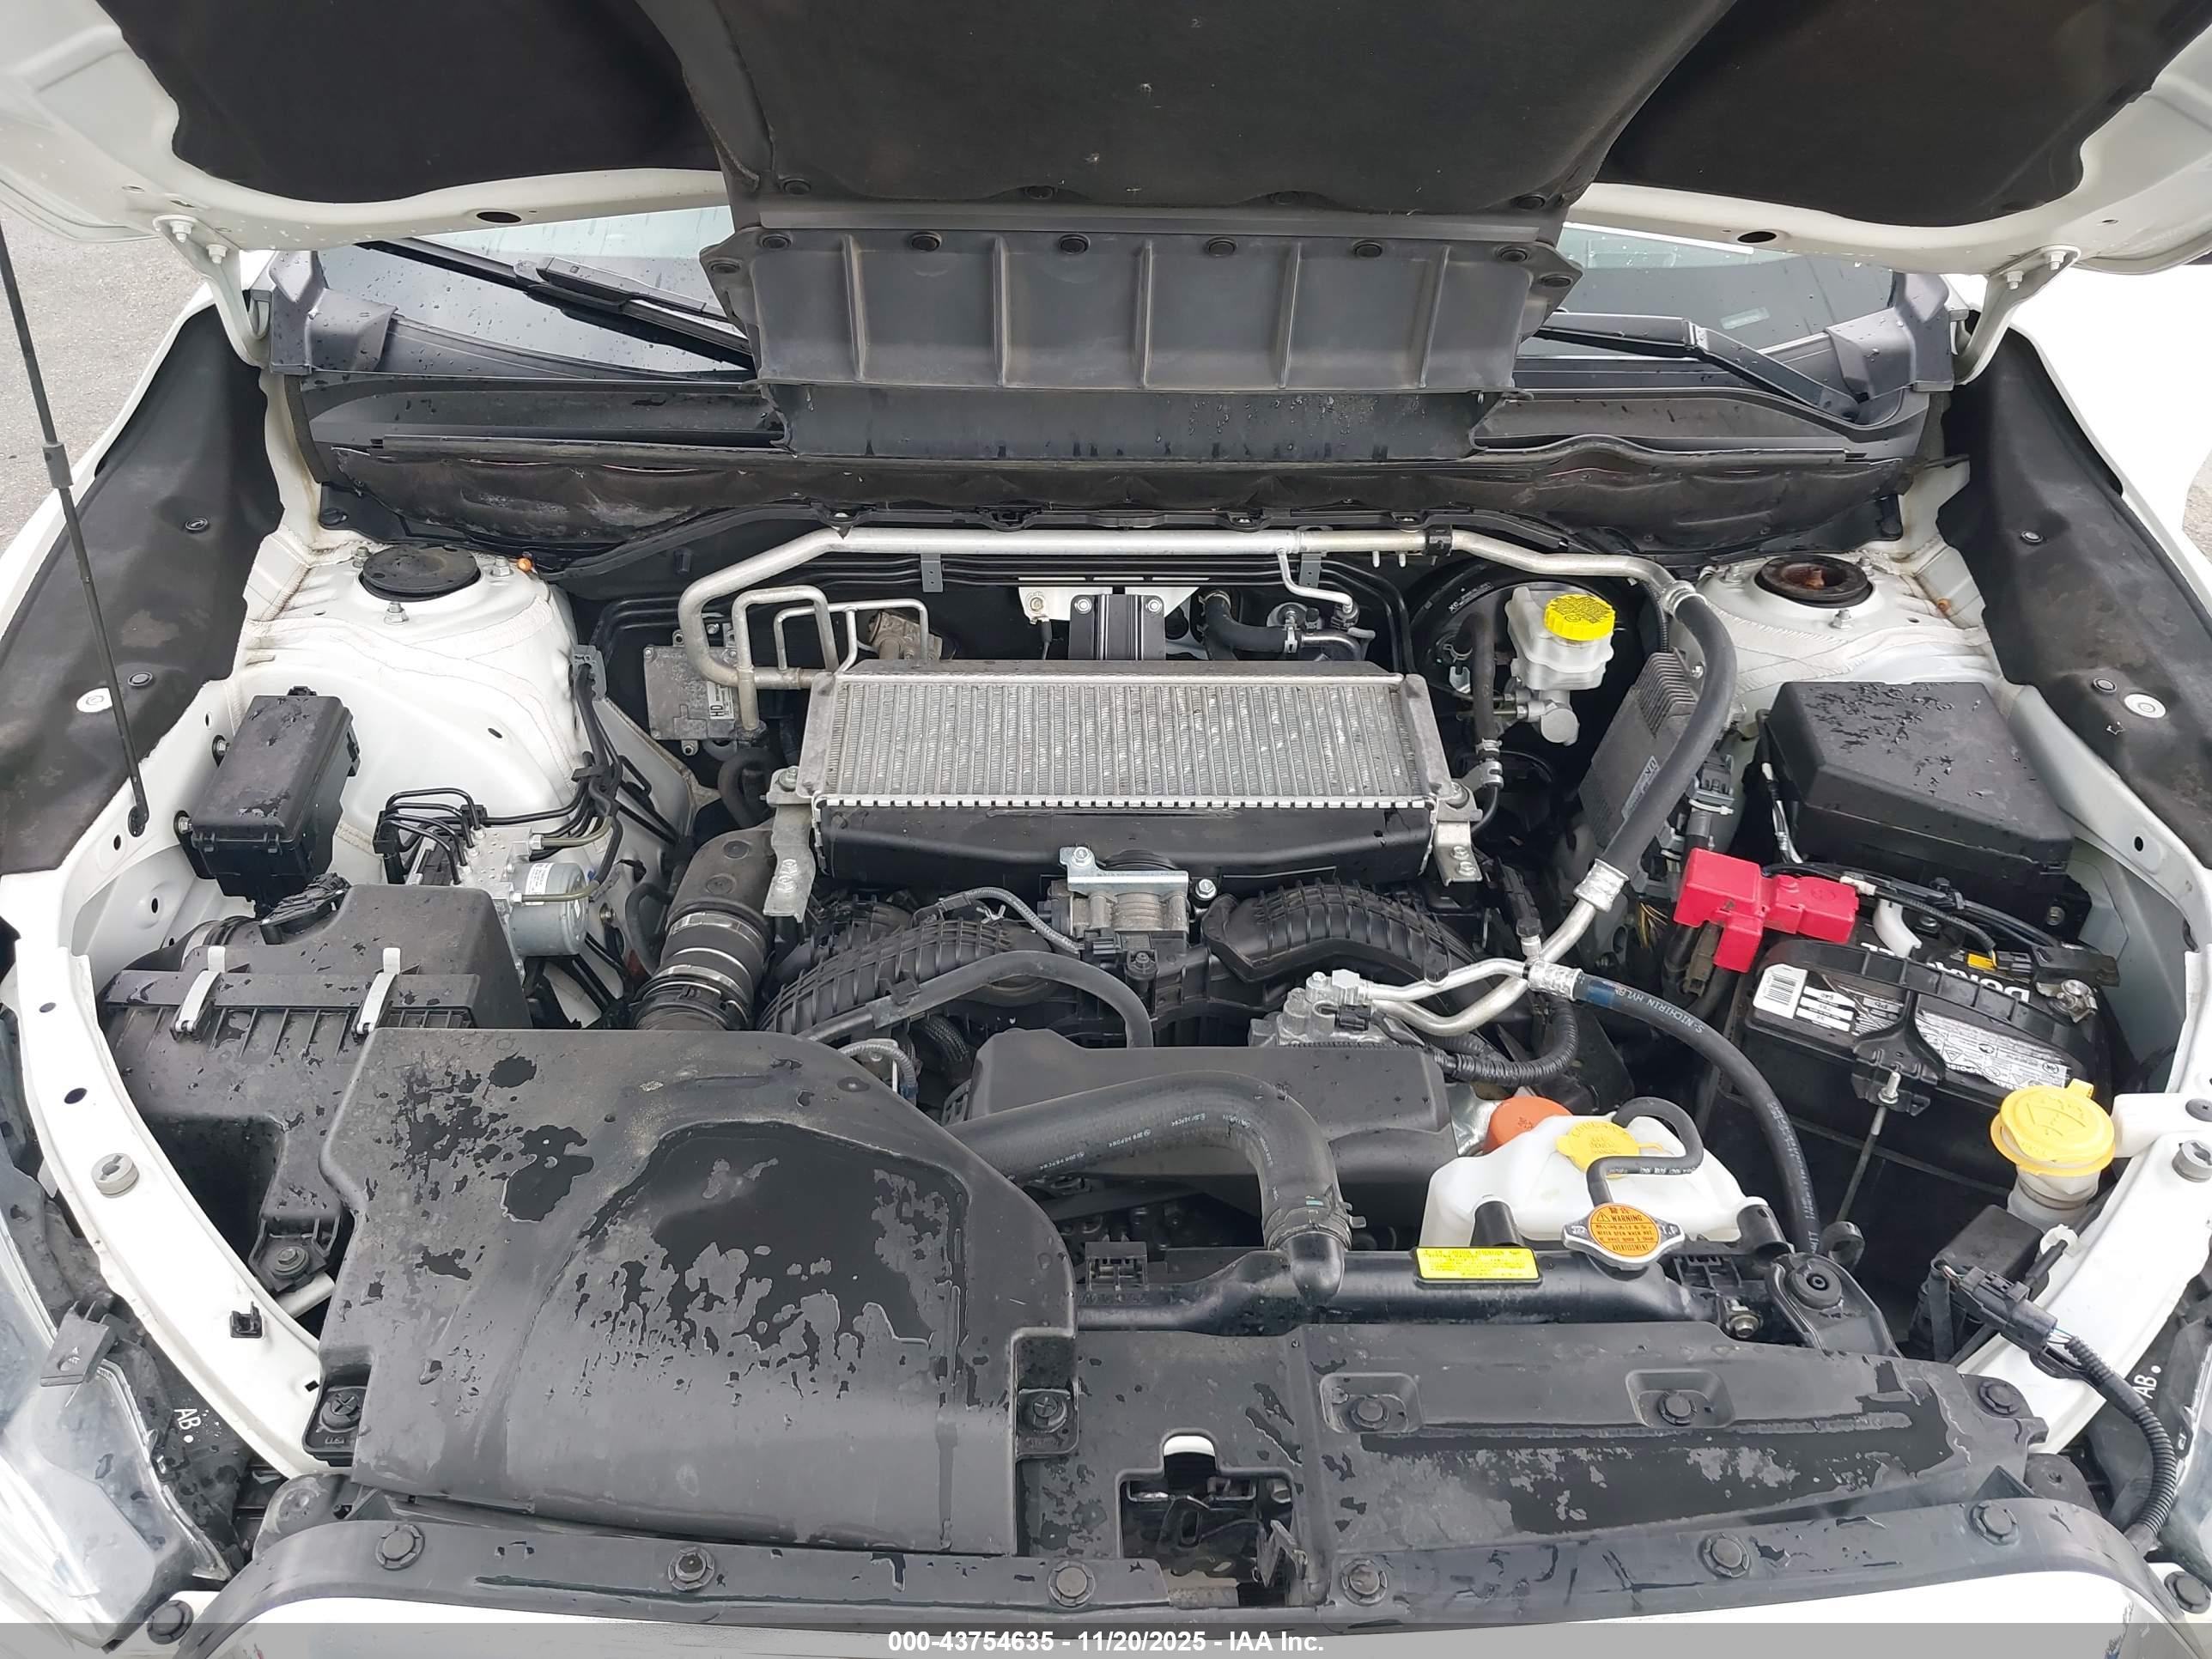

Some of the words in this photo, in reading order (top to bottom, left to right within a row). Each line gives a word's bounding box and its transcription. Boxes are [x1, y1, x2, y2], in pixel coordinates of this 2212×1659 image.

[710, 705, 724, 716] HD
[2132, 1375, 2157, 1400] AB
[173, 1408, 202, 1431] AB
